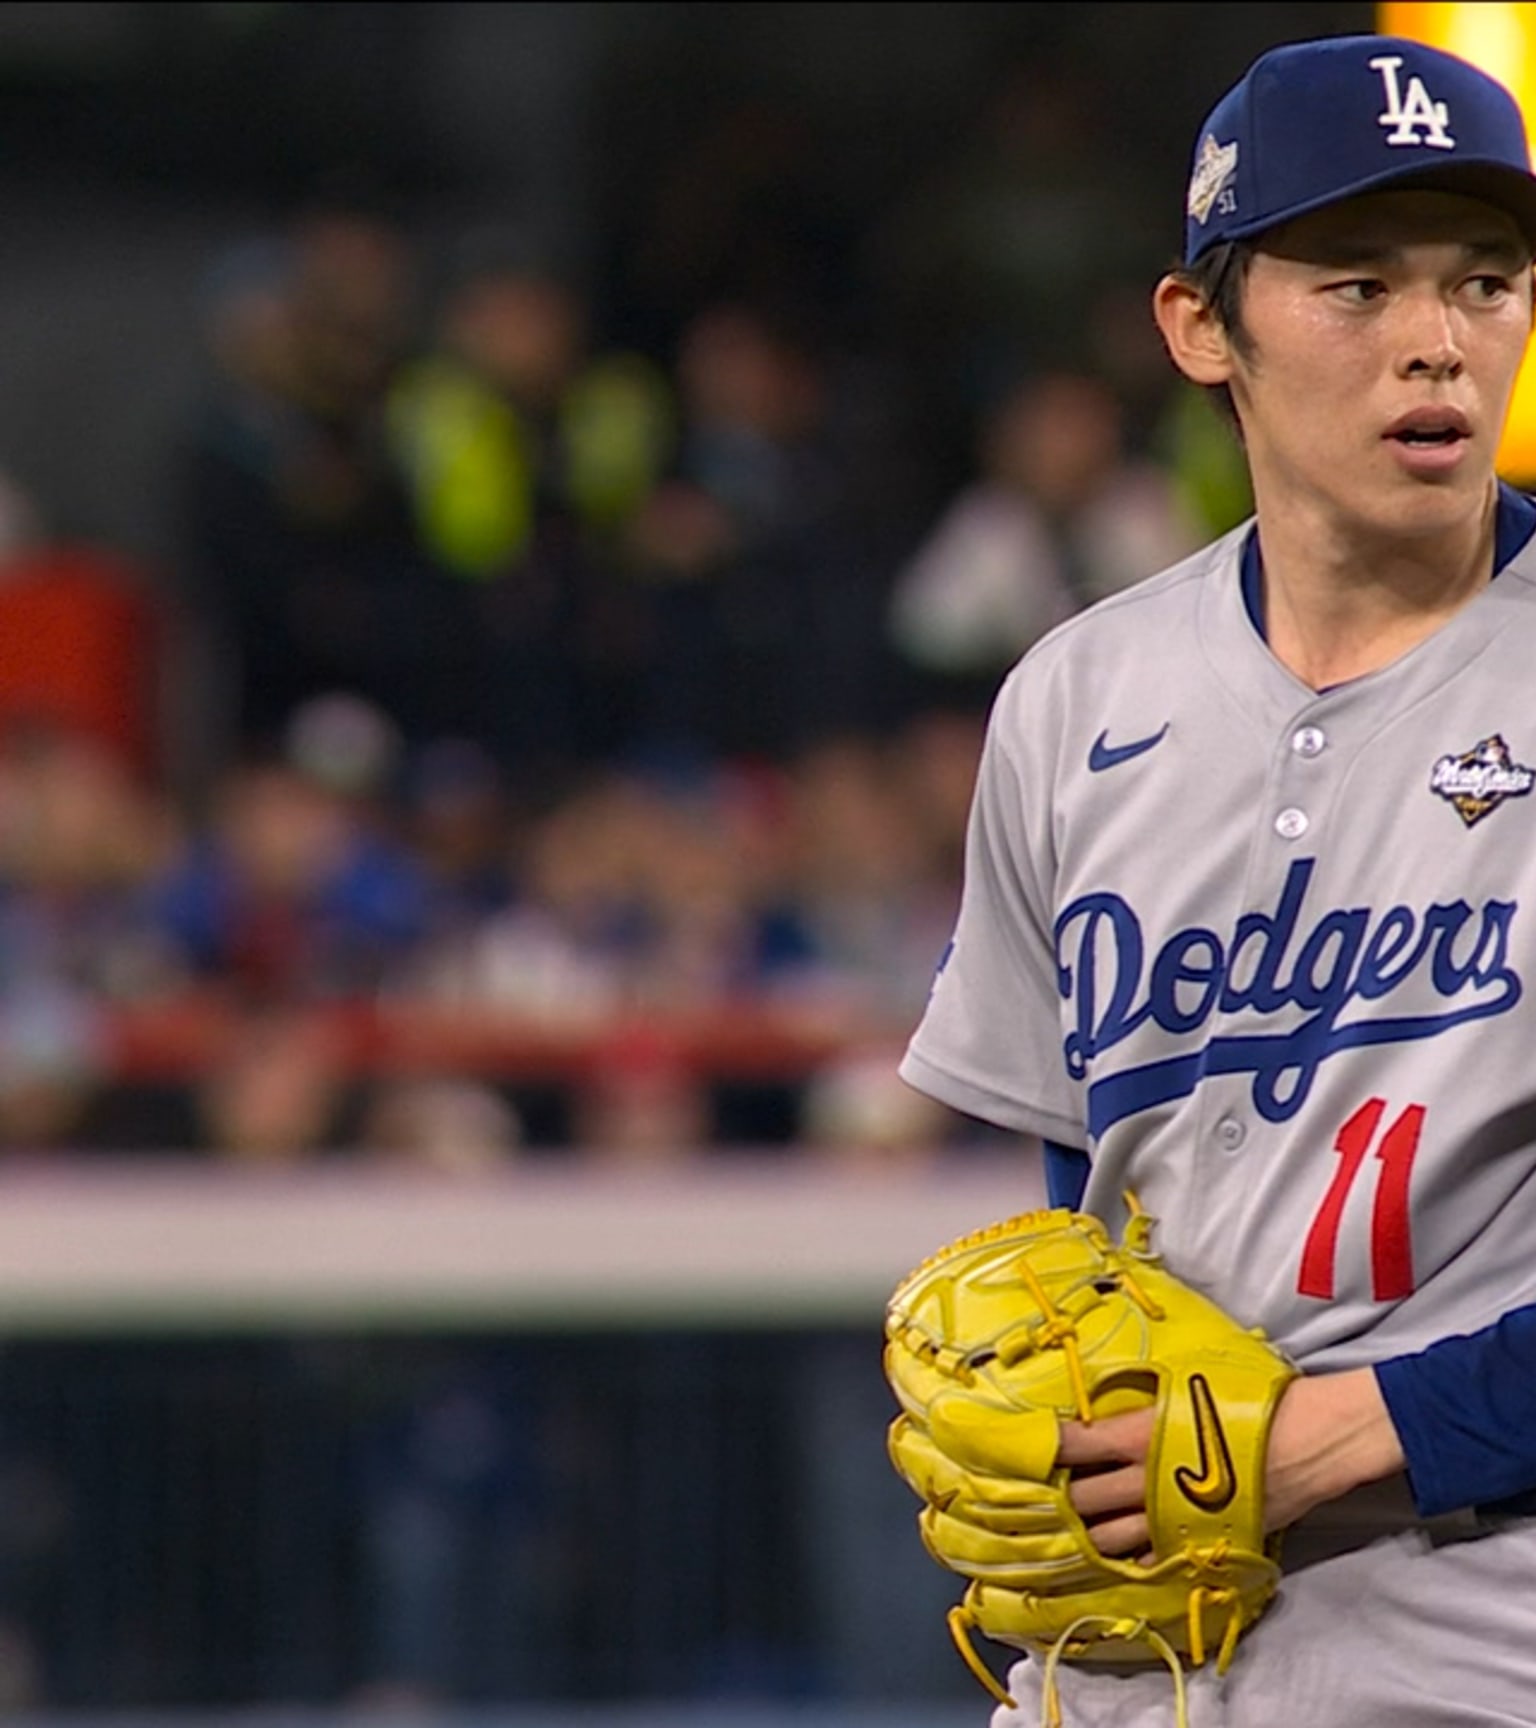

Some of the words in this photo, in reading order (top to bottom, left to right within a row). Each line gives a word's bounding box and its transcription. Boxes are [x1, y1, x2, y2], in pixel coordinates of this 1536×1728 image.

[1370, 57, 1455, 148] LA
[1217, 188, 1237, 214] 51
[1054, 857, 1522, 1123] Dodgers
[1297, 1097, 1427, 1303] 11
